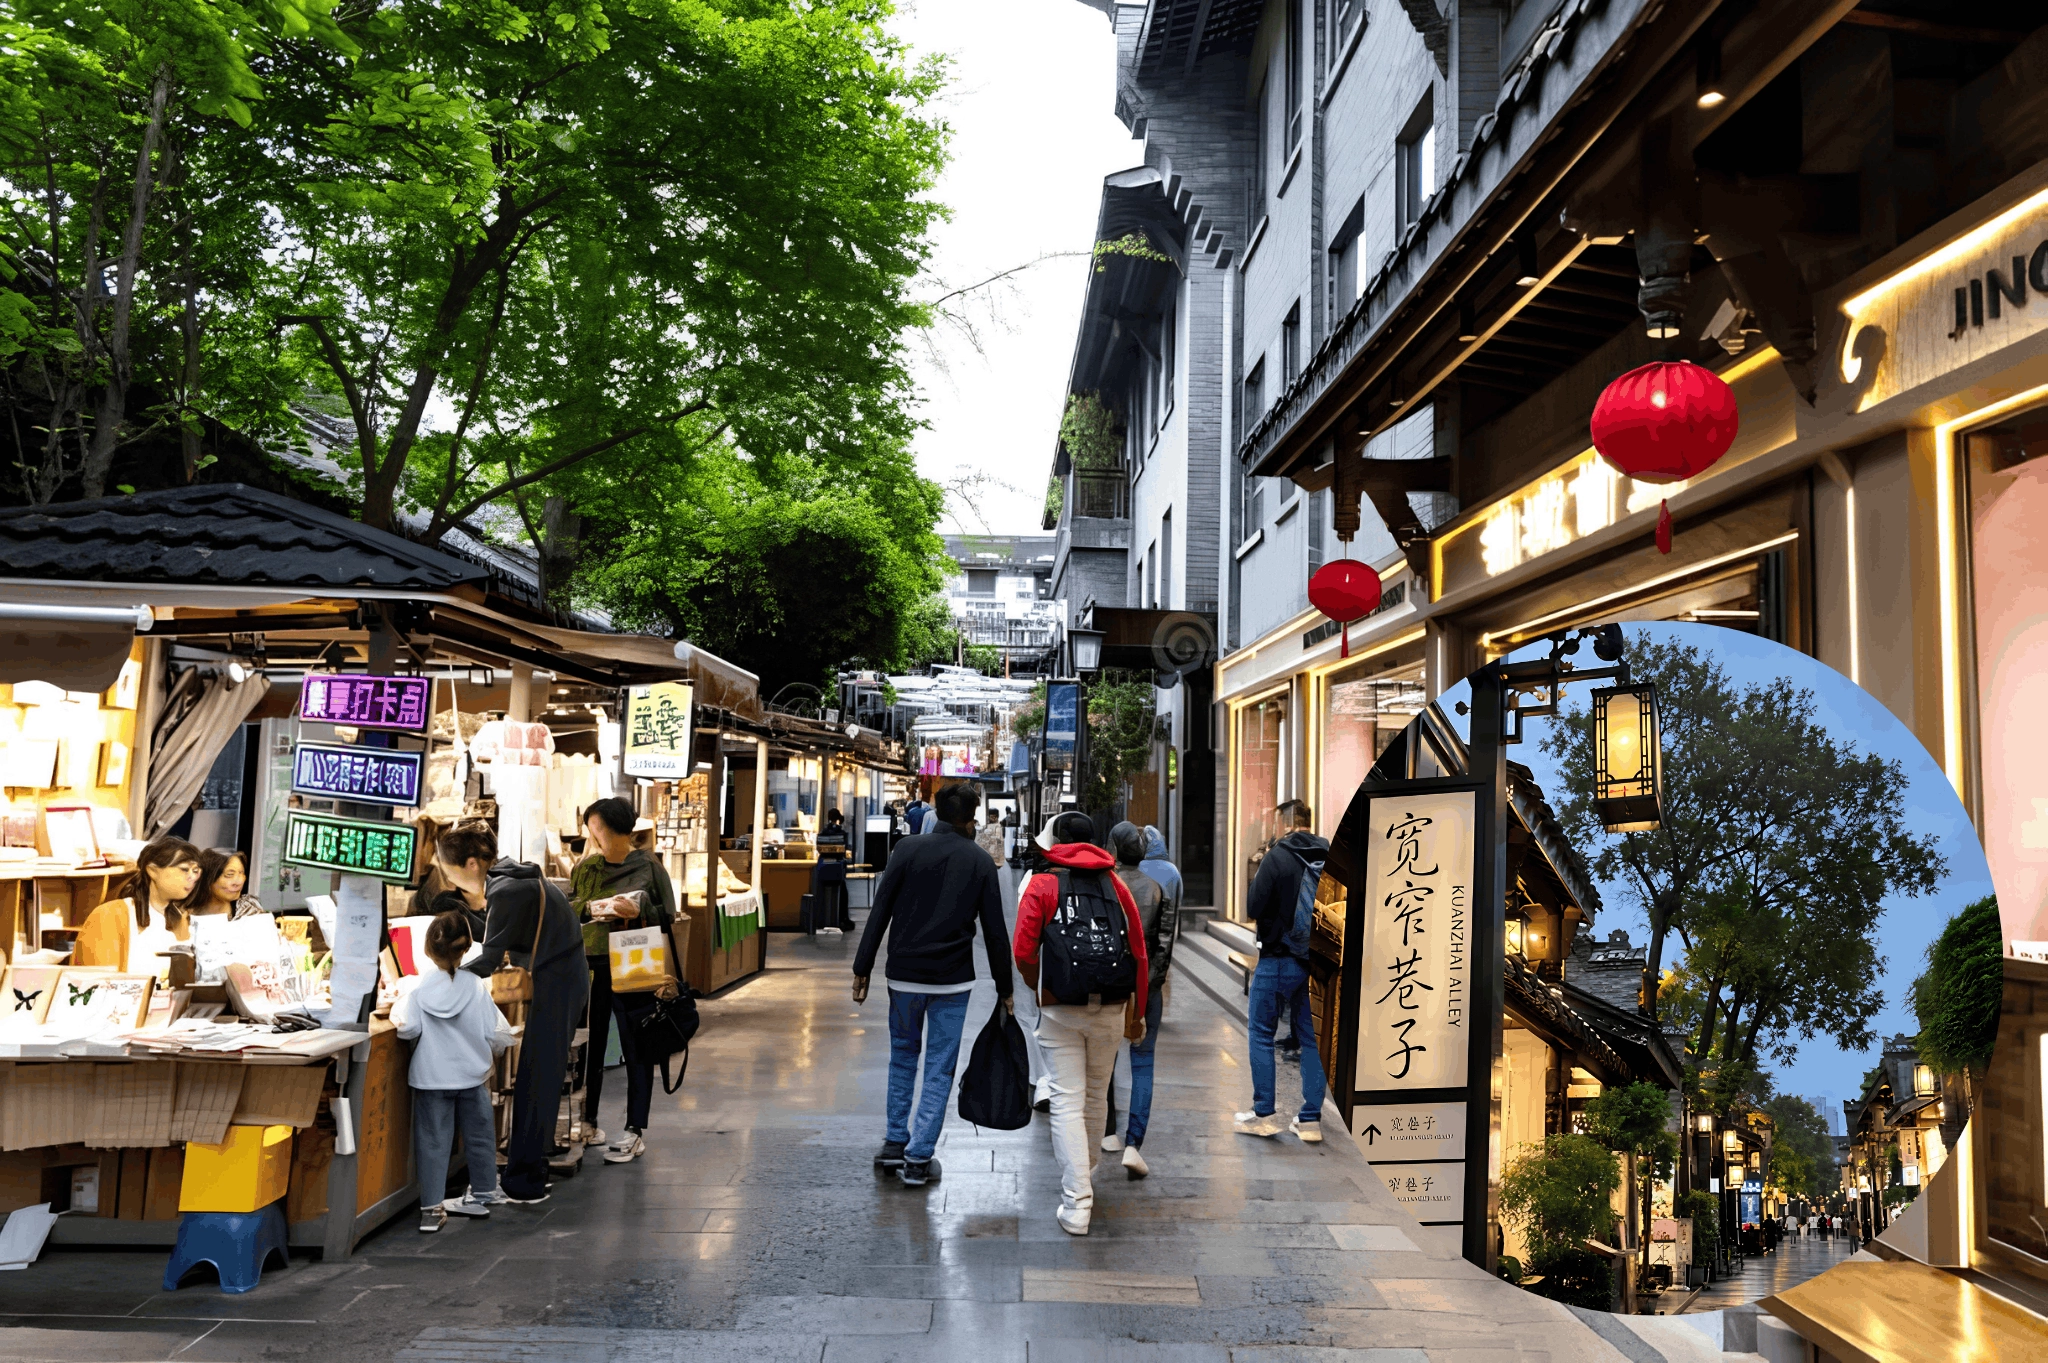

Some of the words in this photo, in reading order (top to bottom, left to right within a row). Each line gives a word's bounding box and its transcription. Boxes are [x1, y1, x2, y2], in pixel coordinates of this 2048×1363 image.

[1375, 812, 1439, 1079] 宽窄巷子
[1450, 885, 1465, 970] KUANZHAI
[1447, 977, 1462, 1028] ALLEY
